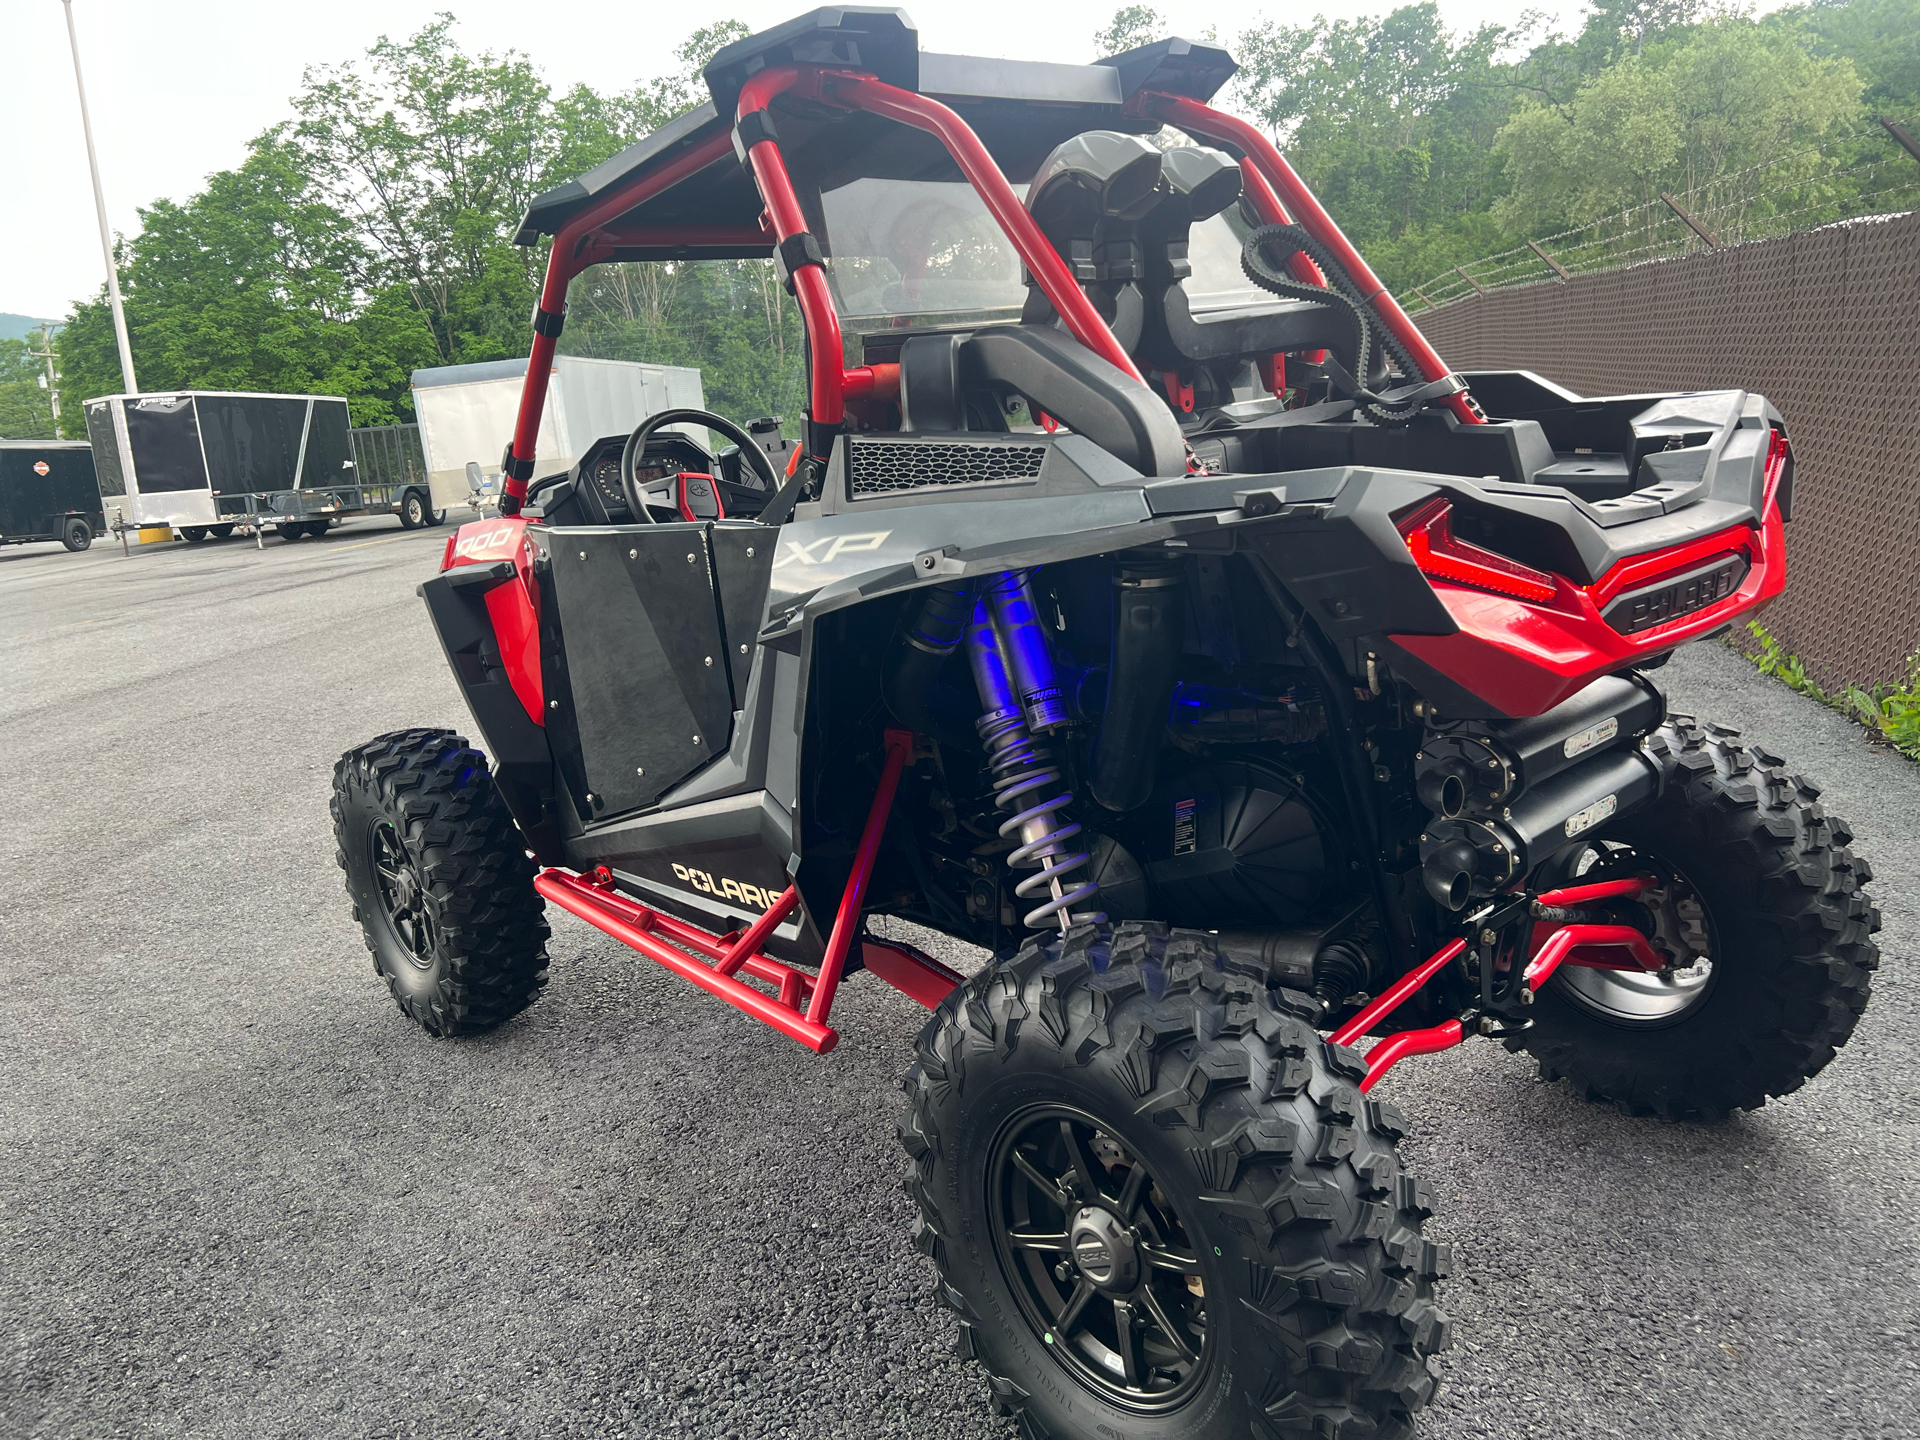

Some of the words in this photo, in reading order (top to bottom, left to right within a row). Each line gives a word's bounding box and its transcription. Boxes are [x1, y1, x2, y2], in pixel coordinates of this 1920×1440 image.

[772, 528, 895, 571] XP
[1626, 565, 1733, 632] POLARIS
[1078, 1251, 1110, 1263] RZR
